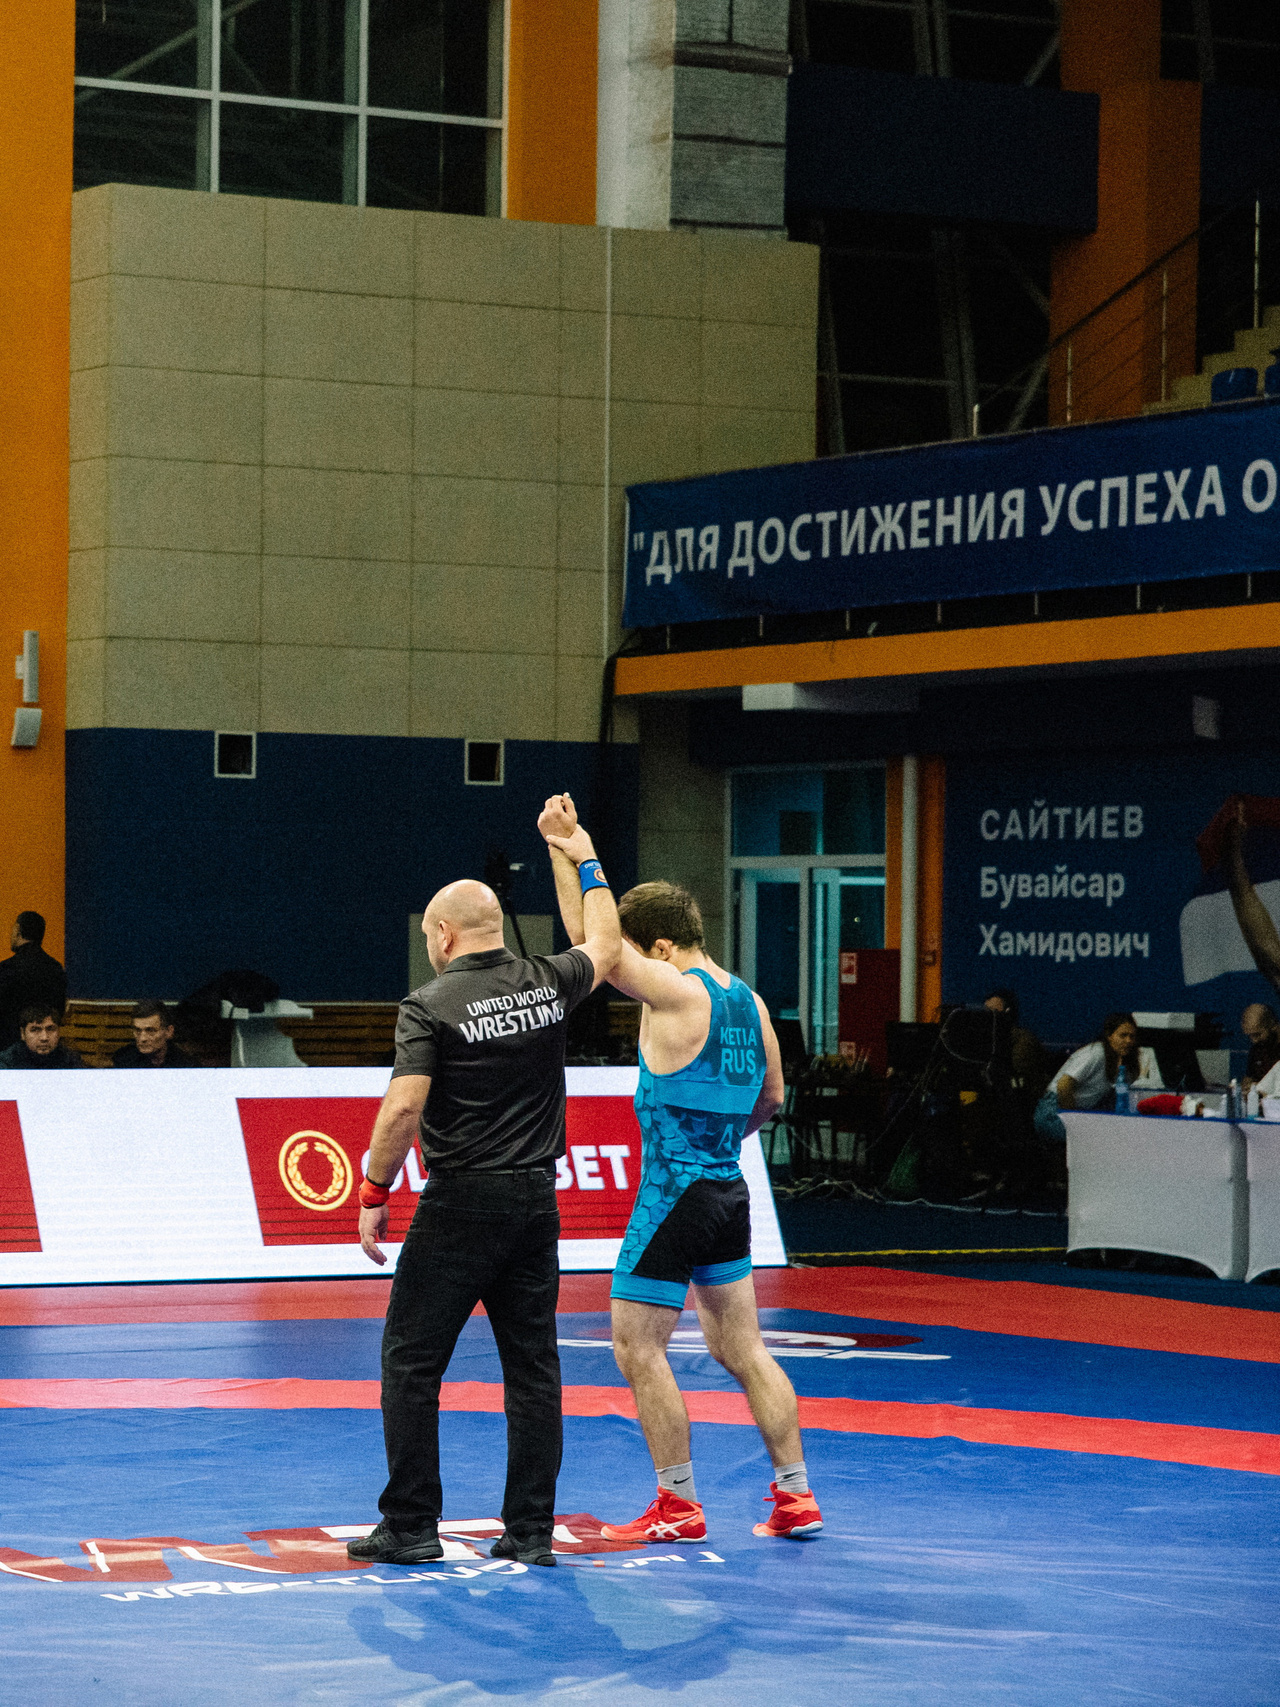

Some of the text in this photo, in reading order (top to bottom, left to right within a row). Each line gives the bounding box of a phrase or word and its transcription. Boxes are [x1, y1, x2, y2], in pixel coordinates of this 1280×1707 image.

[727, 488, 1026, 578] ДОСТИЖЕНИЯ
[1039, 465, 1227, 536] УСПЕХА
[980, 798, 1144, 841] САЙТИЕВ
[980, 864, 1126, 909] Бувайсар
[978, 923, 1150, 963] Хамидович
[459, 1000, 564, 1044] WRESTLING
[466, 986, 557, 1017] UNITED WORLD
[720, 1026, 758, 1047] KETIA
[721, 1048, 757, 1075] RUS
